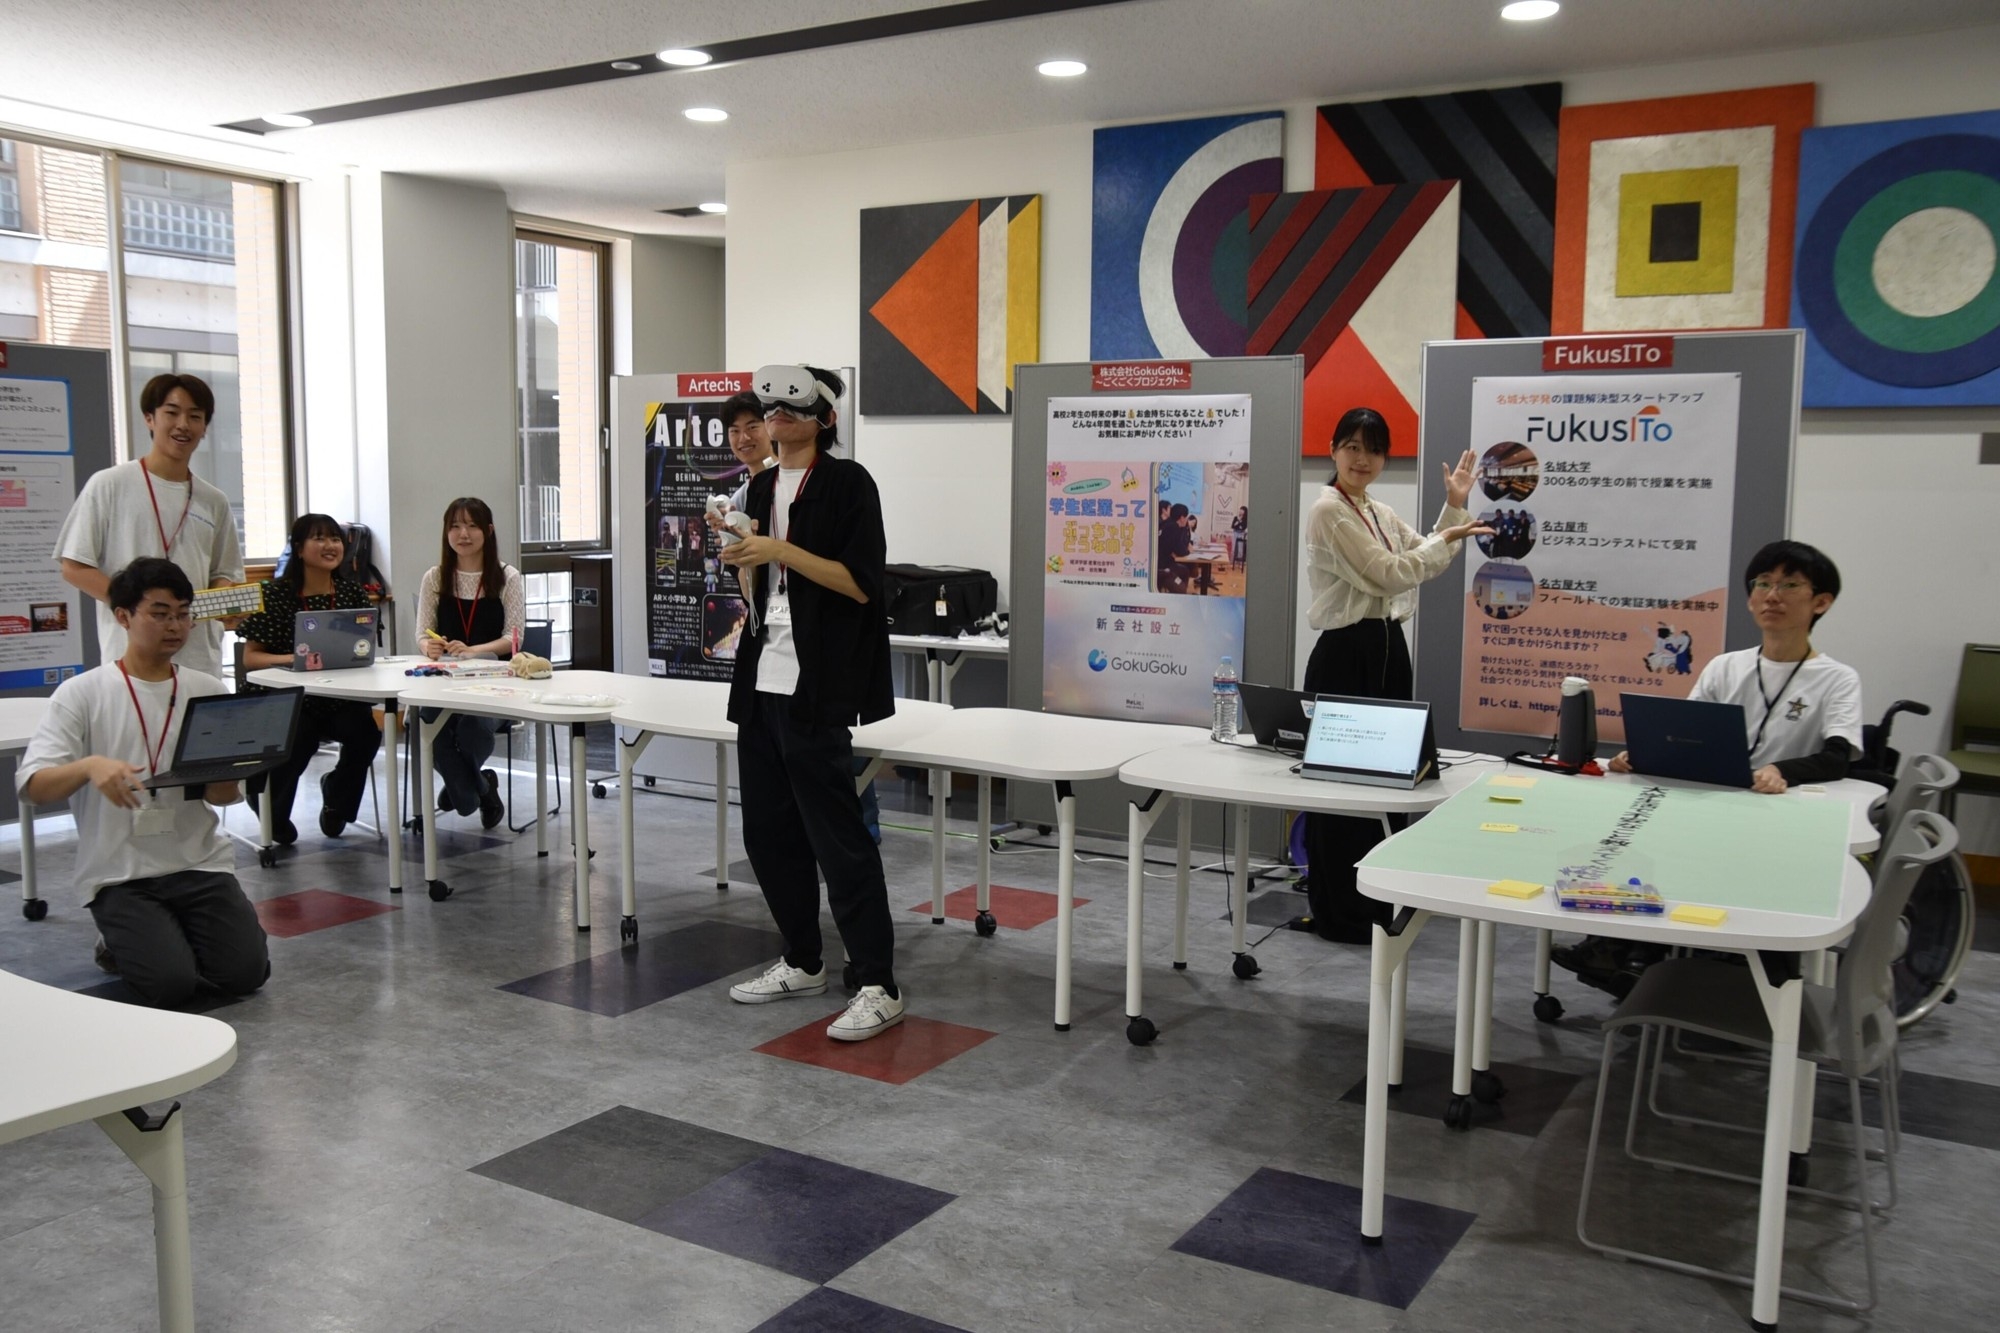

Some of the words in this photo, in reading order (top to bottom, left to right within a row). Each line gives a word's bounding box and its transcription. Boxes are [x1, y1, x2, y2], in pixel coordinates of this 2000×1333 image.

[1555, 344, 1661, 364] FukusITo
[1100, 366, 1183, 377] 株式会社GokuGoku
[689, 377, 741, 392] Artechs
[1497, 392, 1704, 405] 名城大学発の課題解決型スタートアップ
[1053, 410, 1126, 419] 高校2年生の将来の夢は
[1136, 409, 1204, 419] お金持ちになること
[1072, 419, 1224, 429] どんな4年間を過ごしたか気になりませんか？
[1098, 430, 1193, 439] お気軽にお声がけください！
[1543, 461, 1591, 472] 名城大学
[675, 473, 701, 482] BEHIND
[1543, 476, 1713, 489] 300名の学生の前で授業を実施
[1049, 497, 1147, 518] 学生起業って
[1063, 520, 1135, 539] ぶっちゃけ
[1541, 521, 1588, 532] 名古屋市
[1542, 535, 1698, 551] ビジネスコンテストにて受賞
[1539, 578, 1598, 591] 名古屋大学
[1539, 593, 1720, 612] フィールドでの実証実験を実施中
[1096, 617, 1181, 635] 新会社設立
[1482, 623, 1628, 642] 駅で困ってそうな人を見かけたとき
[1482, 636, 1600, 652] すぐに声をかけられますか？
[1111, 657, 1187, 676] GokuGoku
[1481, 656, 1600, 671] 助けたいけど、迷惑だろうか？
